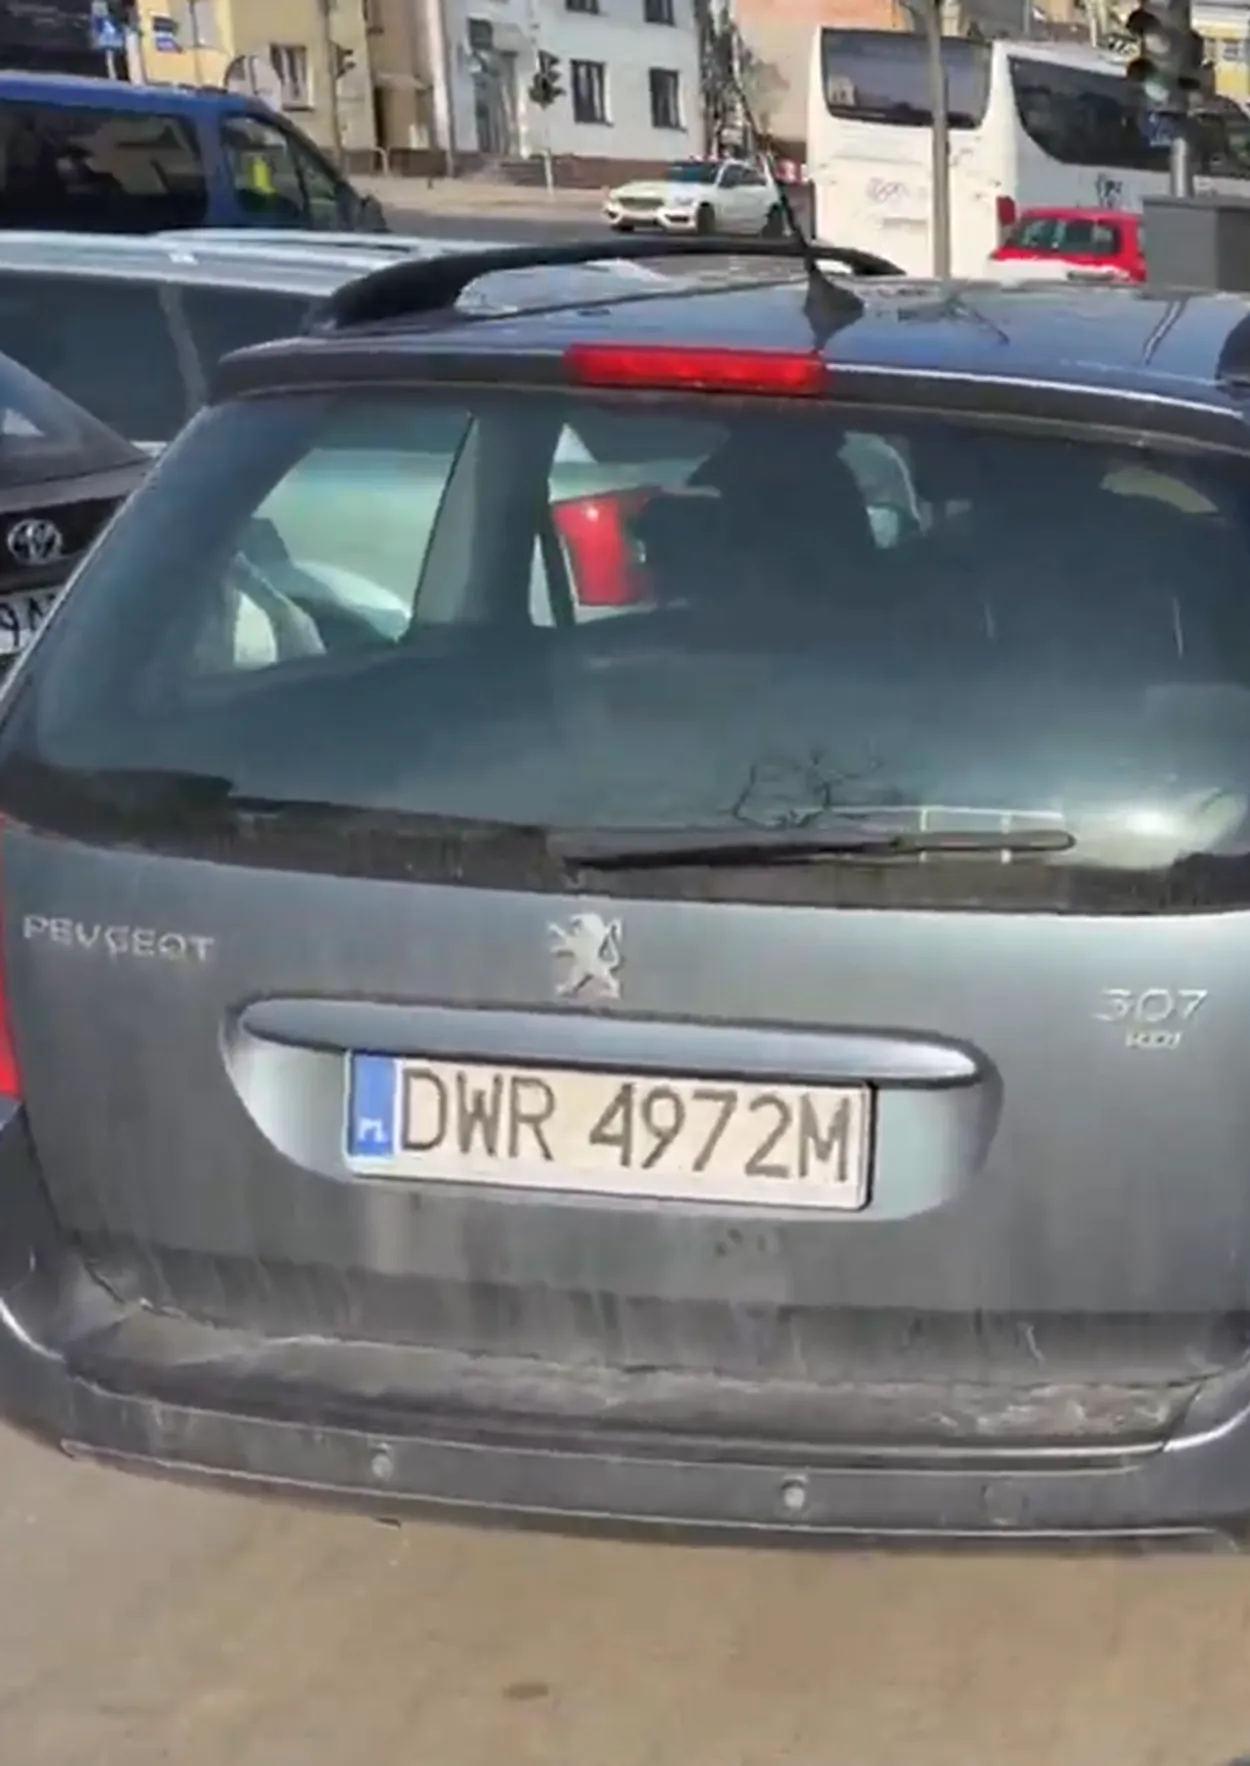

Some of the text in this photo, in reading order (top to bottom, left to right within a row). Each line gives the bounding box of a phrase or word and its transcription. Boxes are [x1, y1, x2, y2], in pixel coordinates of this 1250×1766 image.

[22, 915, 215, 962] PEUGEOT
[1094, 987, 1208, 1022] 307
[400, 1067, 851, 1183] DWR 4972M
